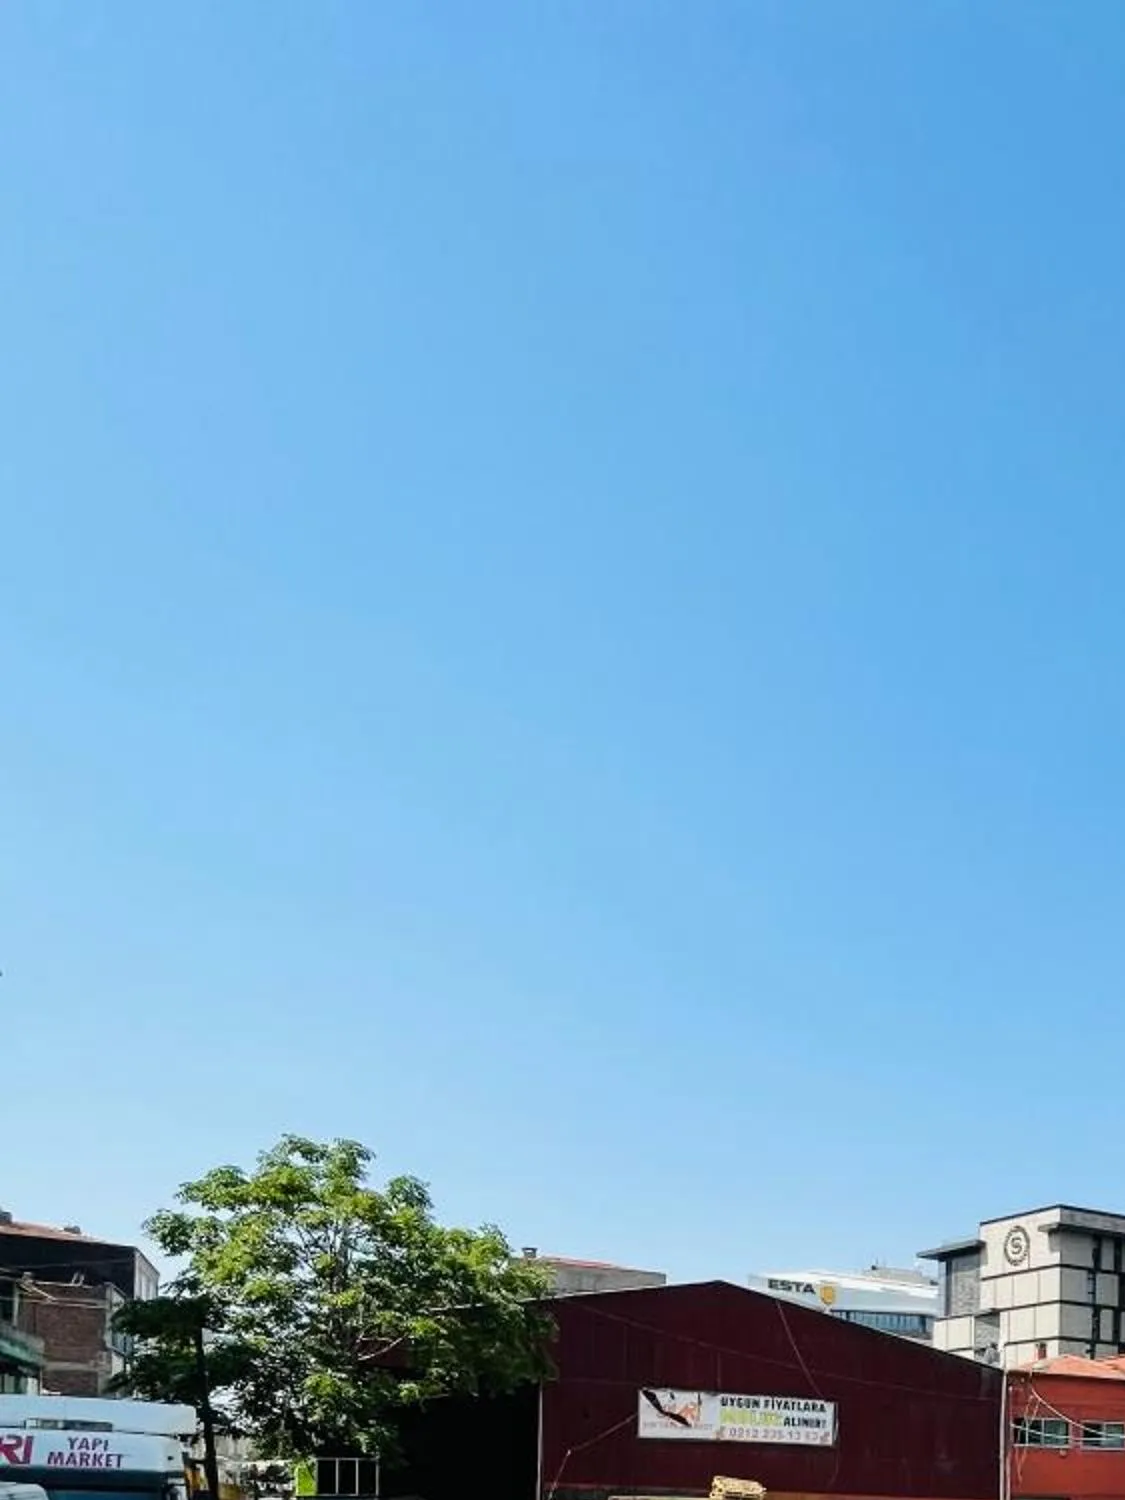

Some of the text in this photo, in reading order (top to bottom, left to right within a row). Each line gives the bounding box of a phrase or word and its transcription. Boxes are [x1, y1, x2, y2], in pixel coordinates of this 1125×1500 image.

[767, 1279, 816, 1294] ESTA
[721, 1397, 760, 1409] UYGUN
[67, 1437, 109, 1451] YAPI
[47, 1452, 123, 1468] MARKET
